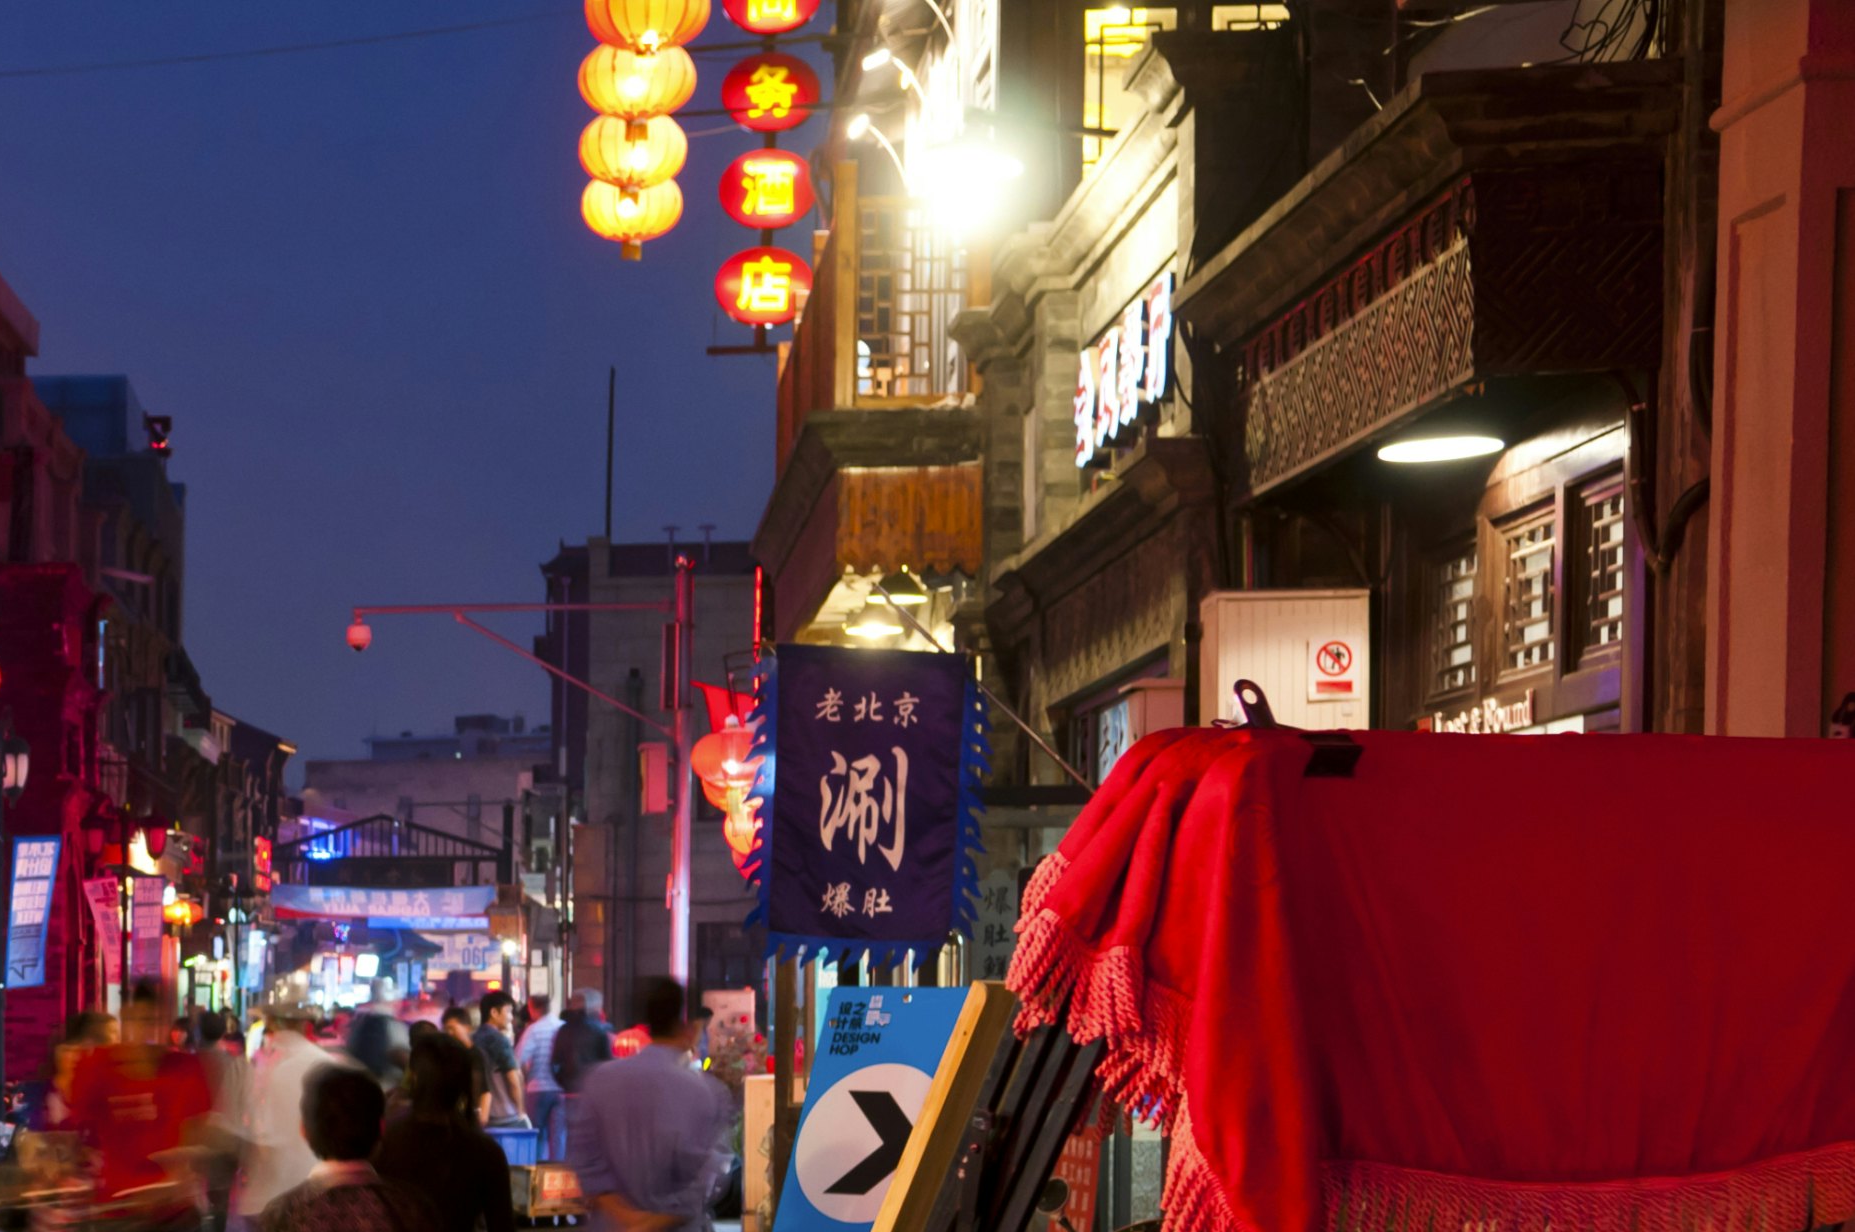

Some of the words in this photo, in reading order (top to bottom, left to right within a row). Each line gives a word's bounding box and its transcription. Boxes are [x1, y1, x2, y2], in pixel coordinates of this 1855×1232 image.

[815, 687, 920, 729] 老北京
[819, 745, 909, 873] 涮
[821, 882, 894, 920] 爆肚
[829, 1044, 859, 1056] HOP
[832, 1032, 881, 1044] DESIGN
